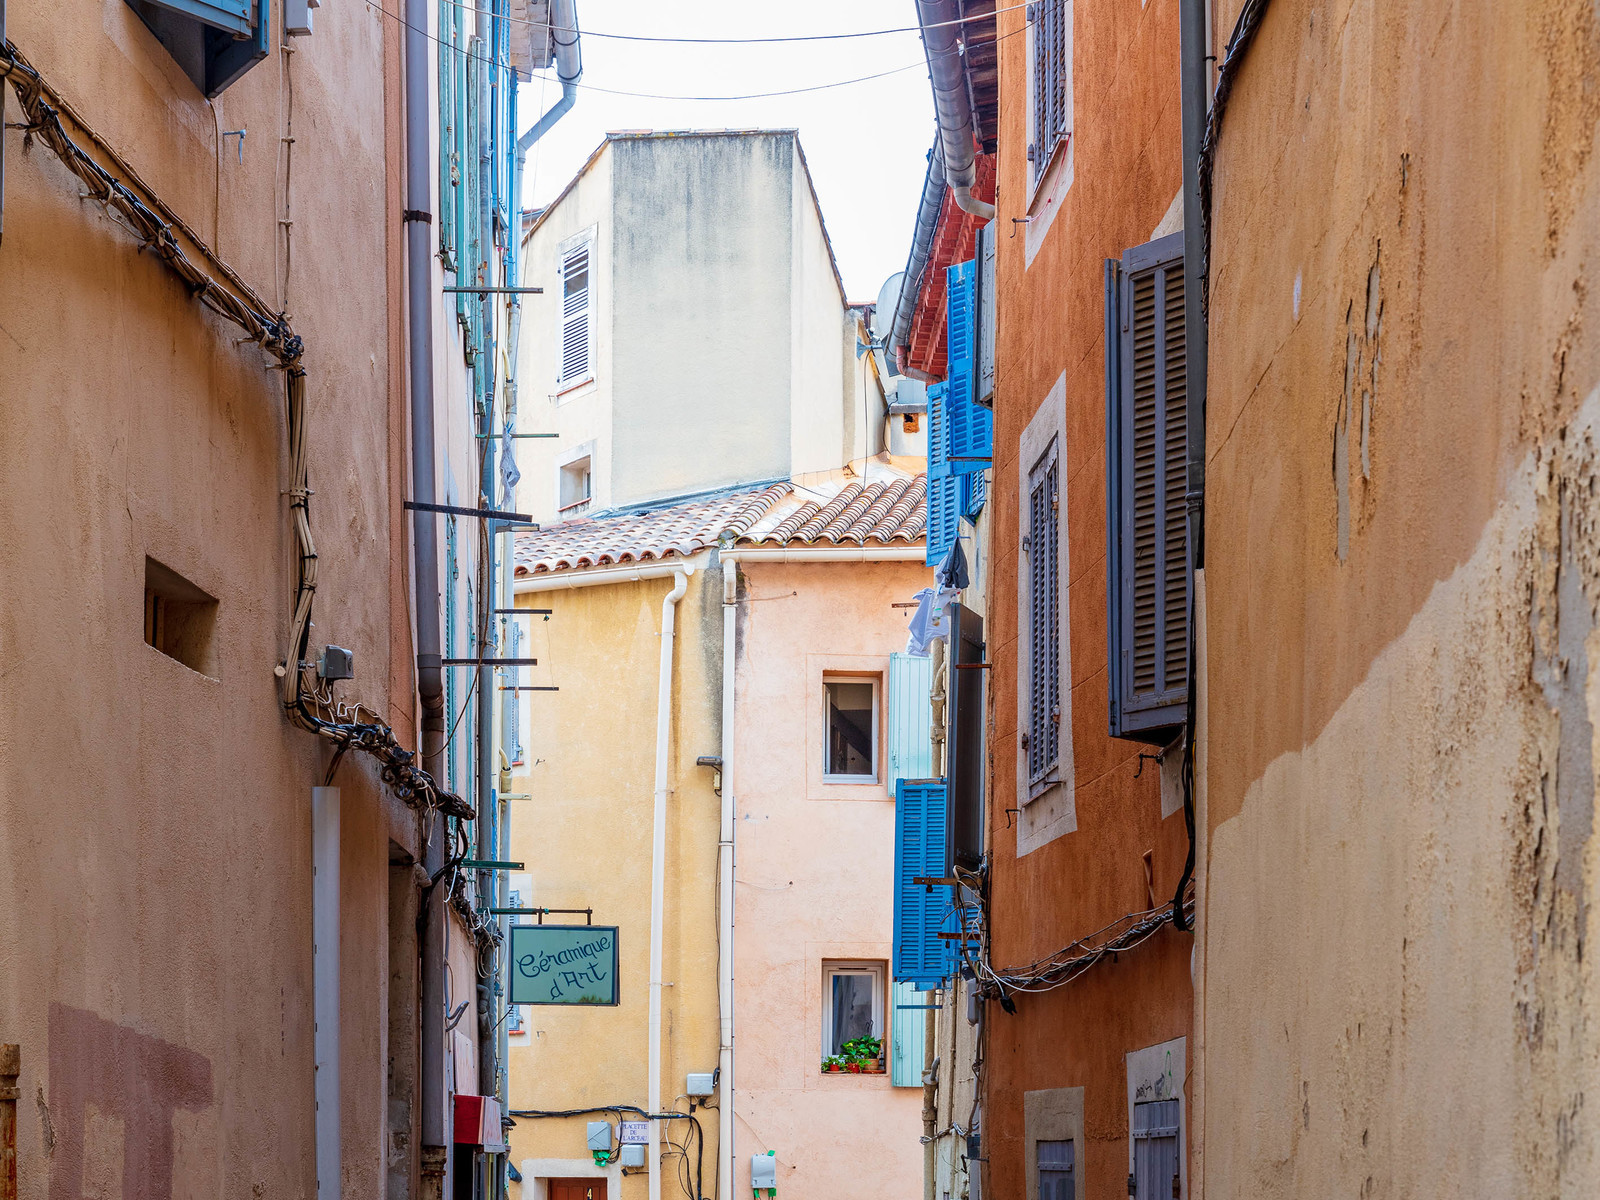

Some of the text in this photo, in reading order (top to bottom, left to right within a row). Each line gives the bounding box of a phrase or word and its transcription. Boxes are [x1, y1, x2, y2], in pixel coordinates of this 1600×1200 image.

[516, 936, 611, 978] Céramique
[550, 961, 607, 1000] d'Art
[587, 1188, 593, 1200] 4
